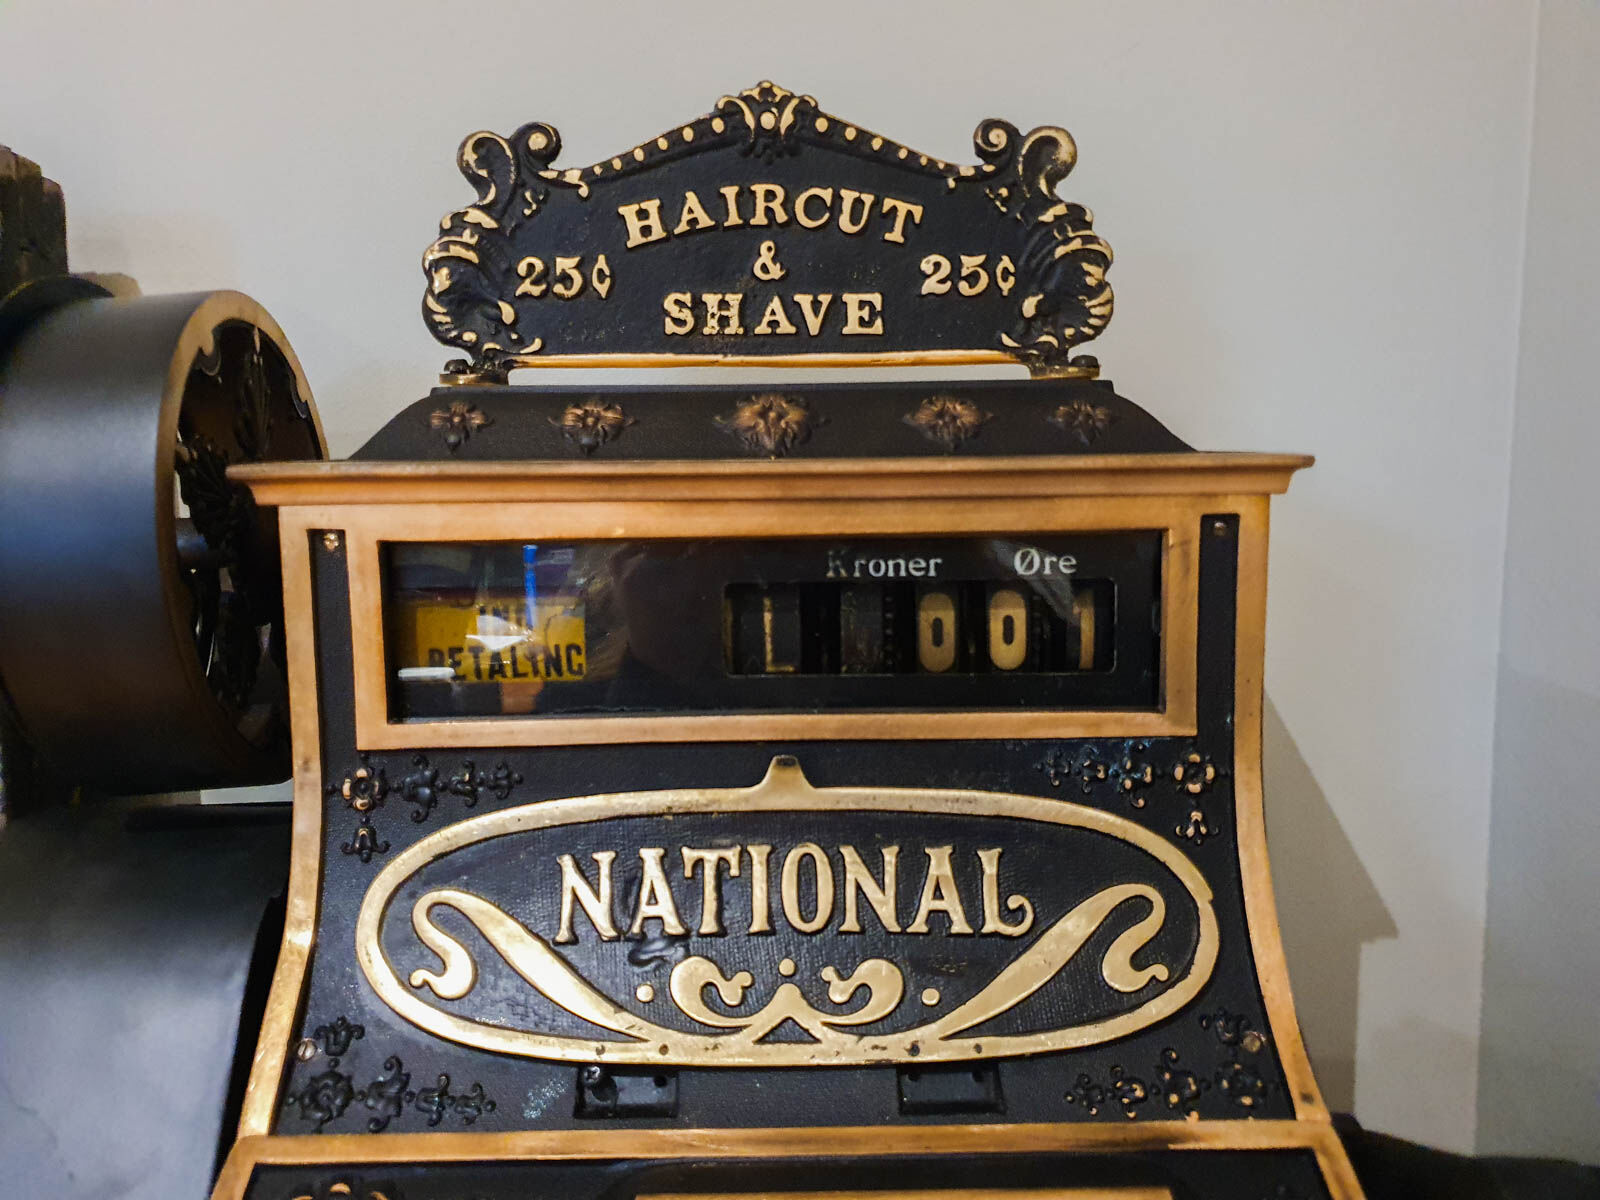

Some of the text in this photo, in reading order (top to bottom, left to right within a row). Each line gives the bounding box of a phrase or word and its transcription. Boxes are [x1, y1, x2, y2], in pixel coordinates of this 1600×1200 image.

[617, 184, 923, 249] HAIRCUT
[514, 254, 611, 299] 25¢
[753, 239, 786, 281] &
[919, 254, 1016, 297] 25¢
[663, 291, 884, 337] SHAVE
[824, 548, 1078, 579] Kroner Øre
[551, 842, 1035, 944] NATIONAL
